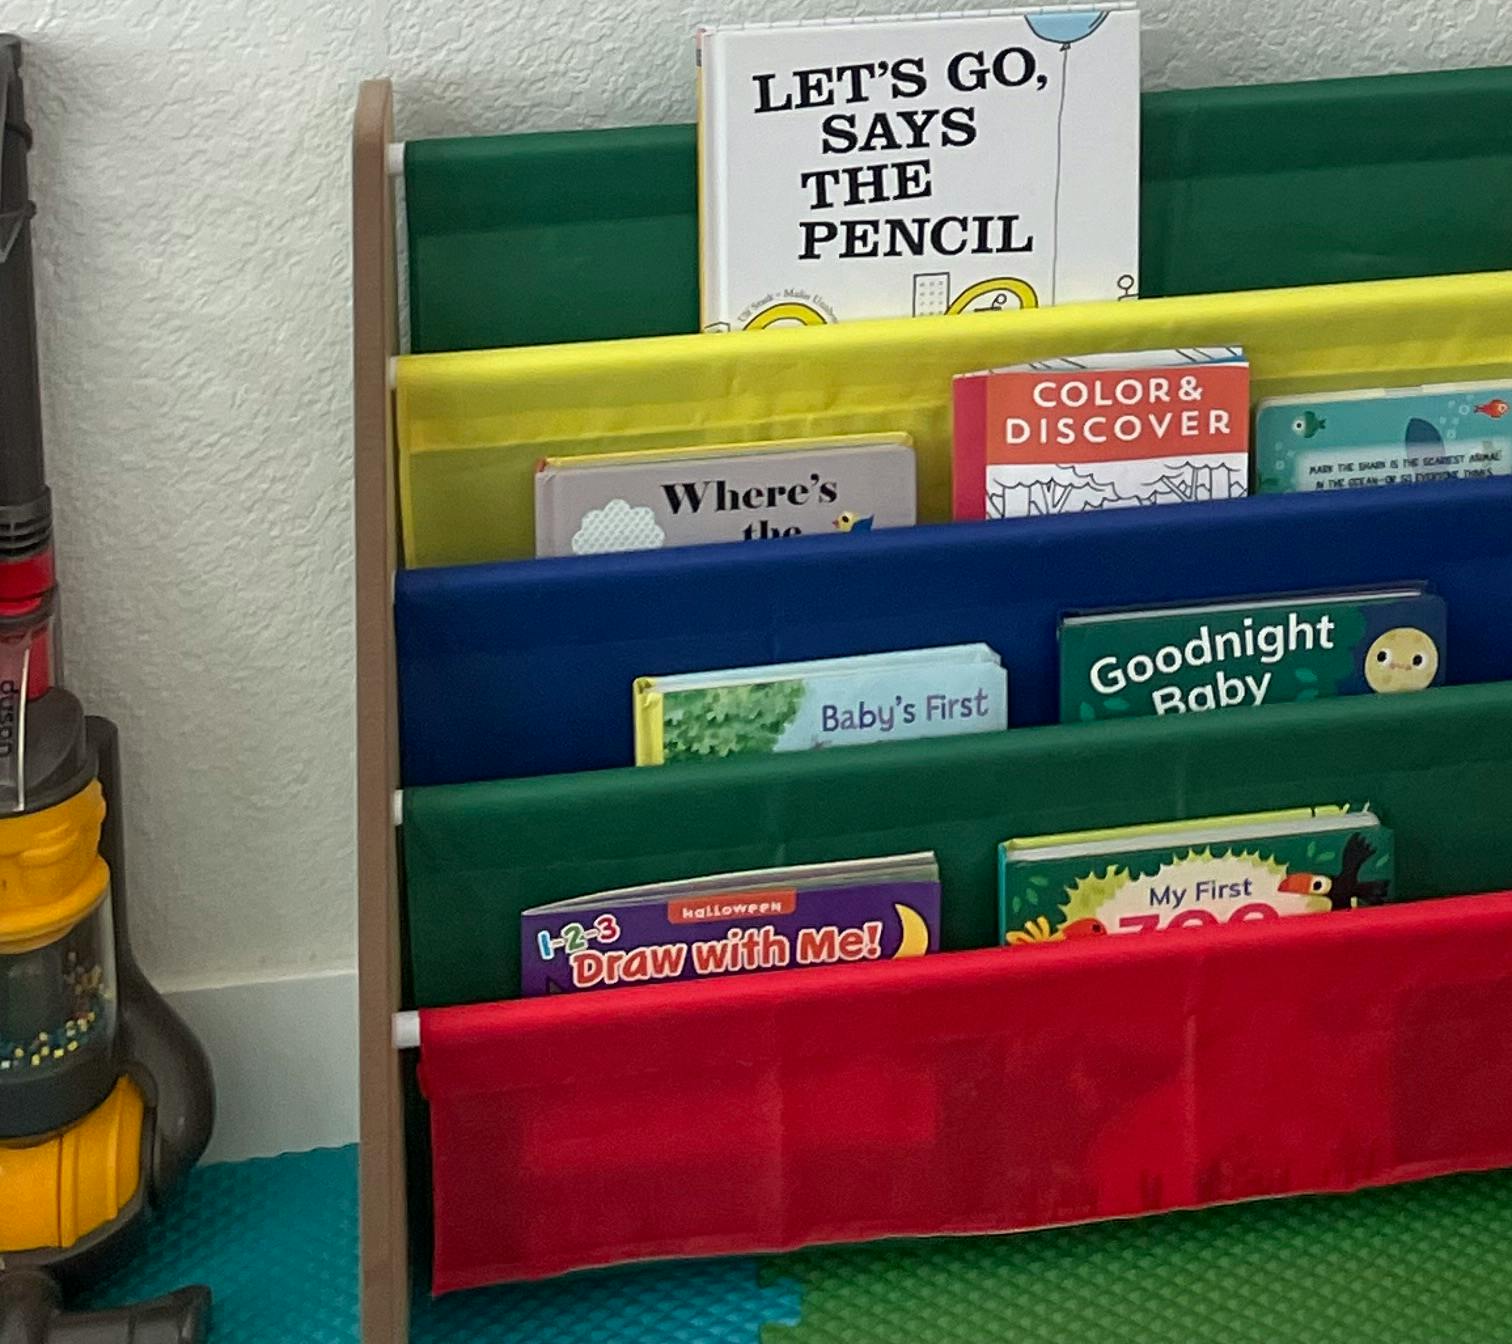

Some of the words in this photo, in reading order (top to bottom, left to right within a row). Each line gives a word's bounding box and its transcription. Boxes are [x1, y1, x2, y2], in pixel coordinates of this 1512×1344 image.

[752, 56, 928, 114] LET'S
[946, 47, 1049, 93] GO,
[820, 106, 978, 155] SAYS
[801, 158, 932, 211] THE
[798, 214, 1035, 260] PENCIL
[1033, 377, 1171, 408] COLOR
[1005, 409, 1231, 444] DISCOVER
[661, 473, 838, 515] Where's
[742, 519, 803, 543] the
[1088, 612, 1336, 695] Goodnight
[821, 694, 917, 733] Baby's
[926, 687, 990, 723] First
[1151, 670, 1273, 716] Baby
[1149, 886, 1188, 911] My
[1195, 877, 1253, 902] First
[538, 913, 621, 960] 1-2-3
[570, 941, 687, 988] Draw
[693, 927, 788, 973] with
[796, 920, 884, 964] Me!
